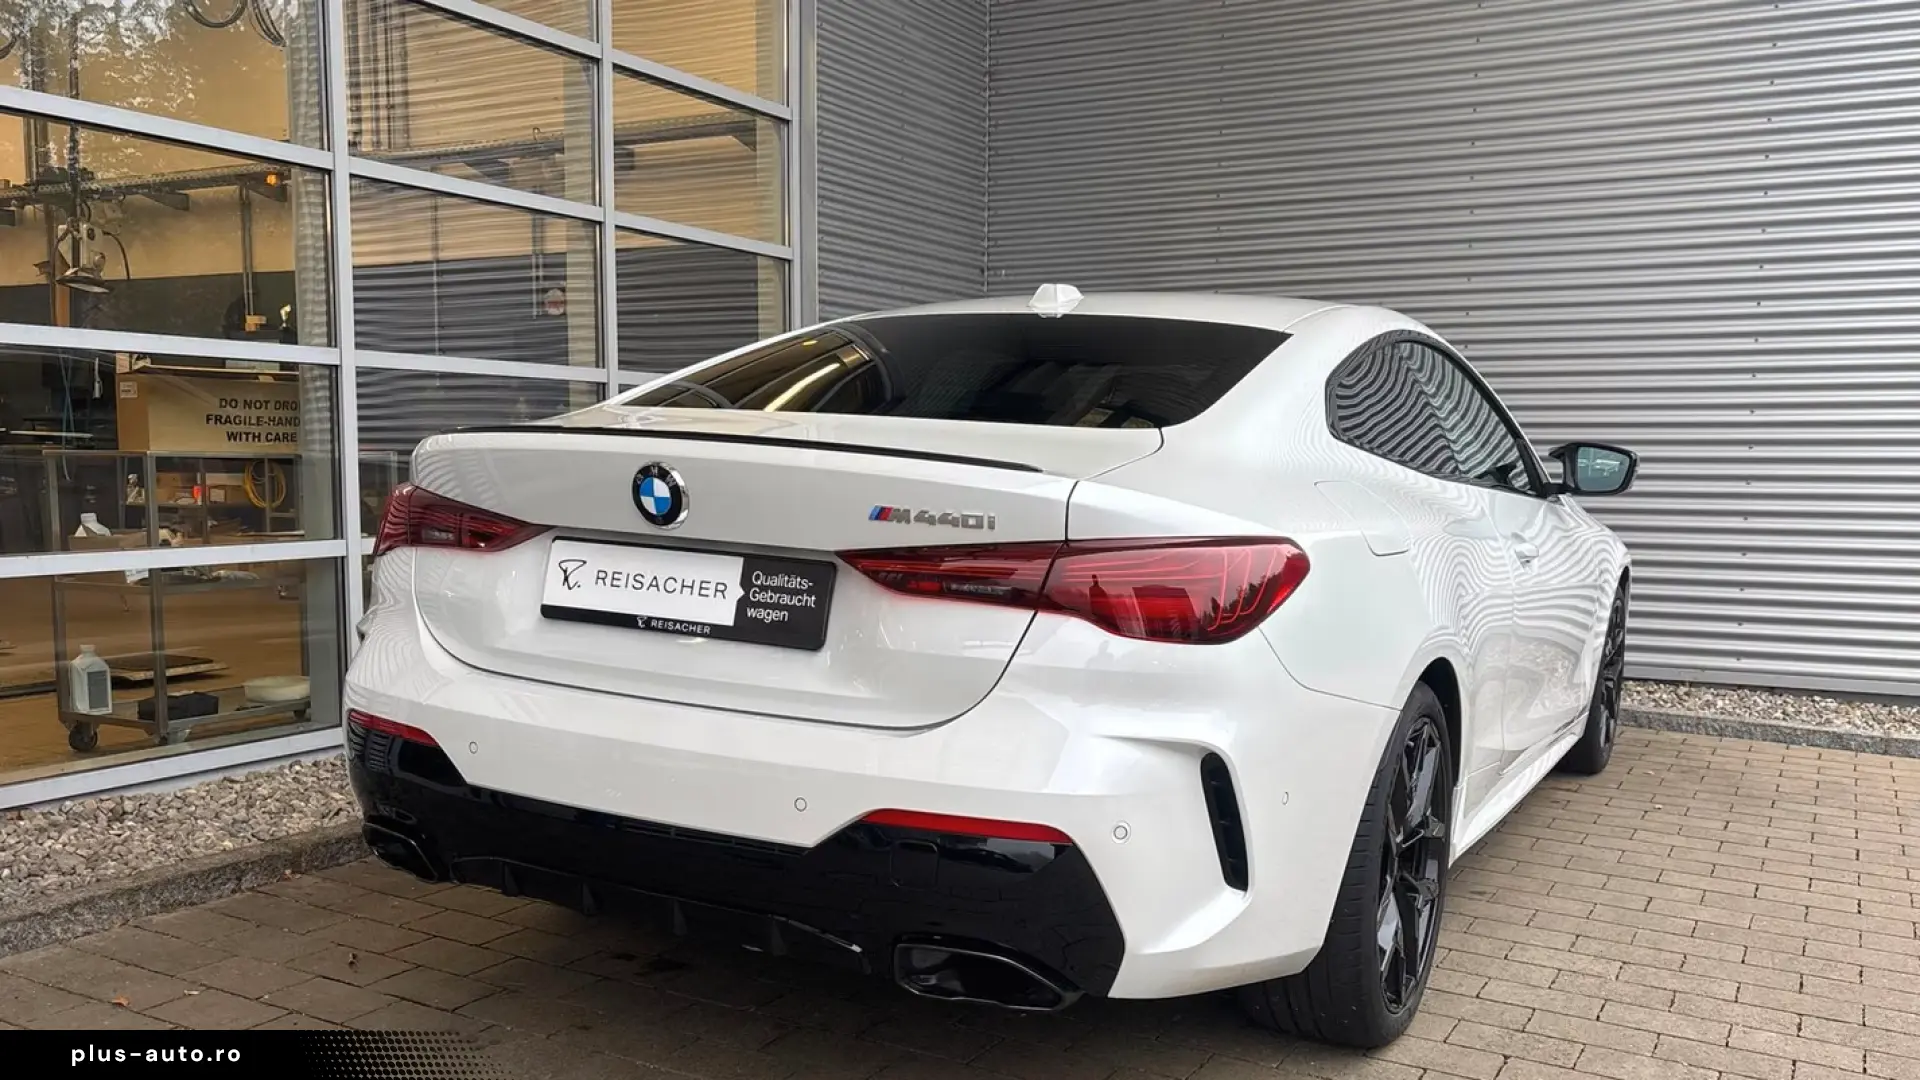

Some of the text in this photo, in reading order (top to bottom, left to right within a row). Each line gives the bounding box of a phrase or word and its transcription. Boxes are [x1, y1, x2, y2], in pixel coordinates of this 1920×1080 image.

[219, 398, 301, 412] DO NOT DRO
[226, 431, 298, 444] WITH CARE
[594, 569, 728, 600] REISACHER
[752, 570, 814, 590] Qualitäts-
[749, 586, 817, 608] Gebraucht
[746, 606, 789, 623] wagen
[650, 618, 712, 635] REISACHER
